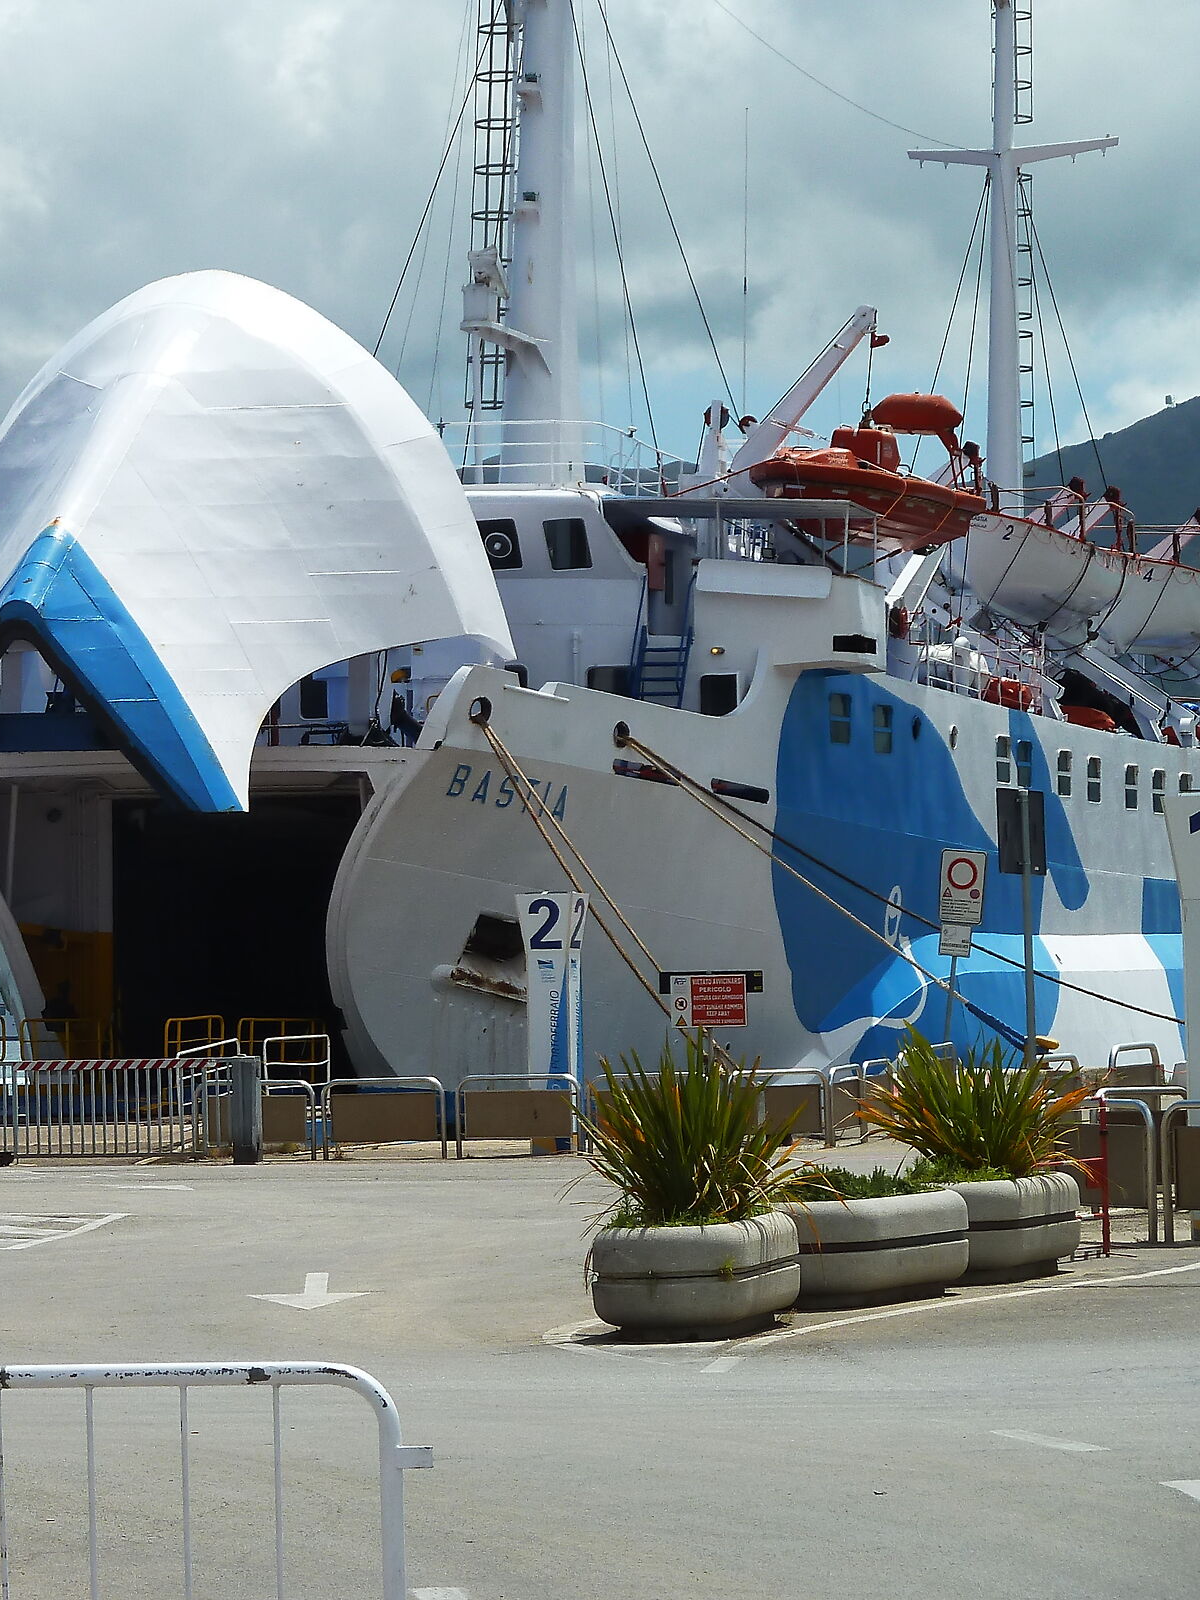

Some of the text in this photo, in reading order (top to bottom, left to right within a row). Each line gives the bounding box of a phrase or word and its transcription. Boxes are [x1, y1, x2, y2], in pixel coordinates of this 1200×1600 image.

[1002, 525, 1014, 540] 2
[1143, 568, 1154, 582] 4
[446, 763, 568, 822] BASTIA
[528, 898, 562, 949] 2
[570, 898, 585, 949] 2
